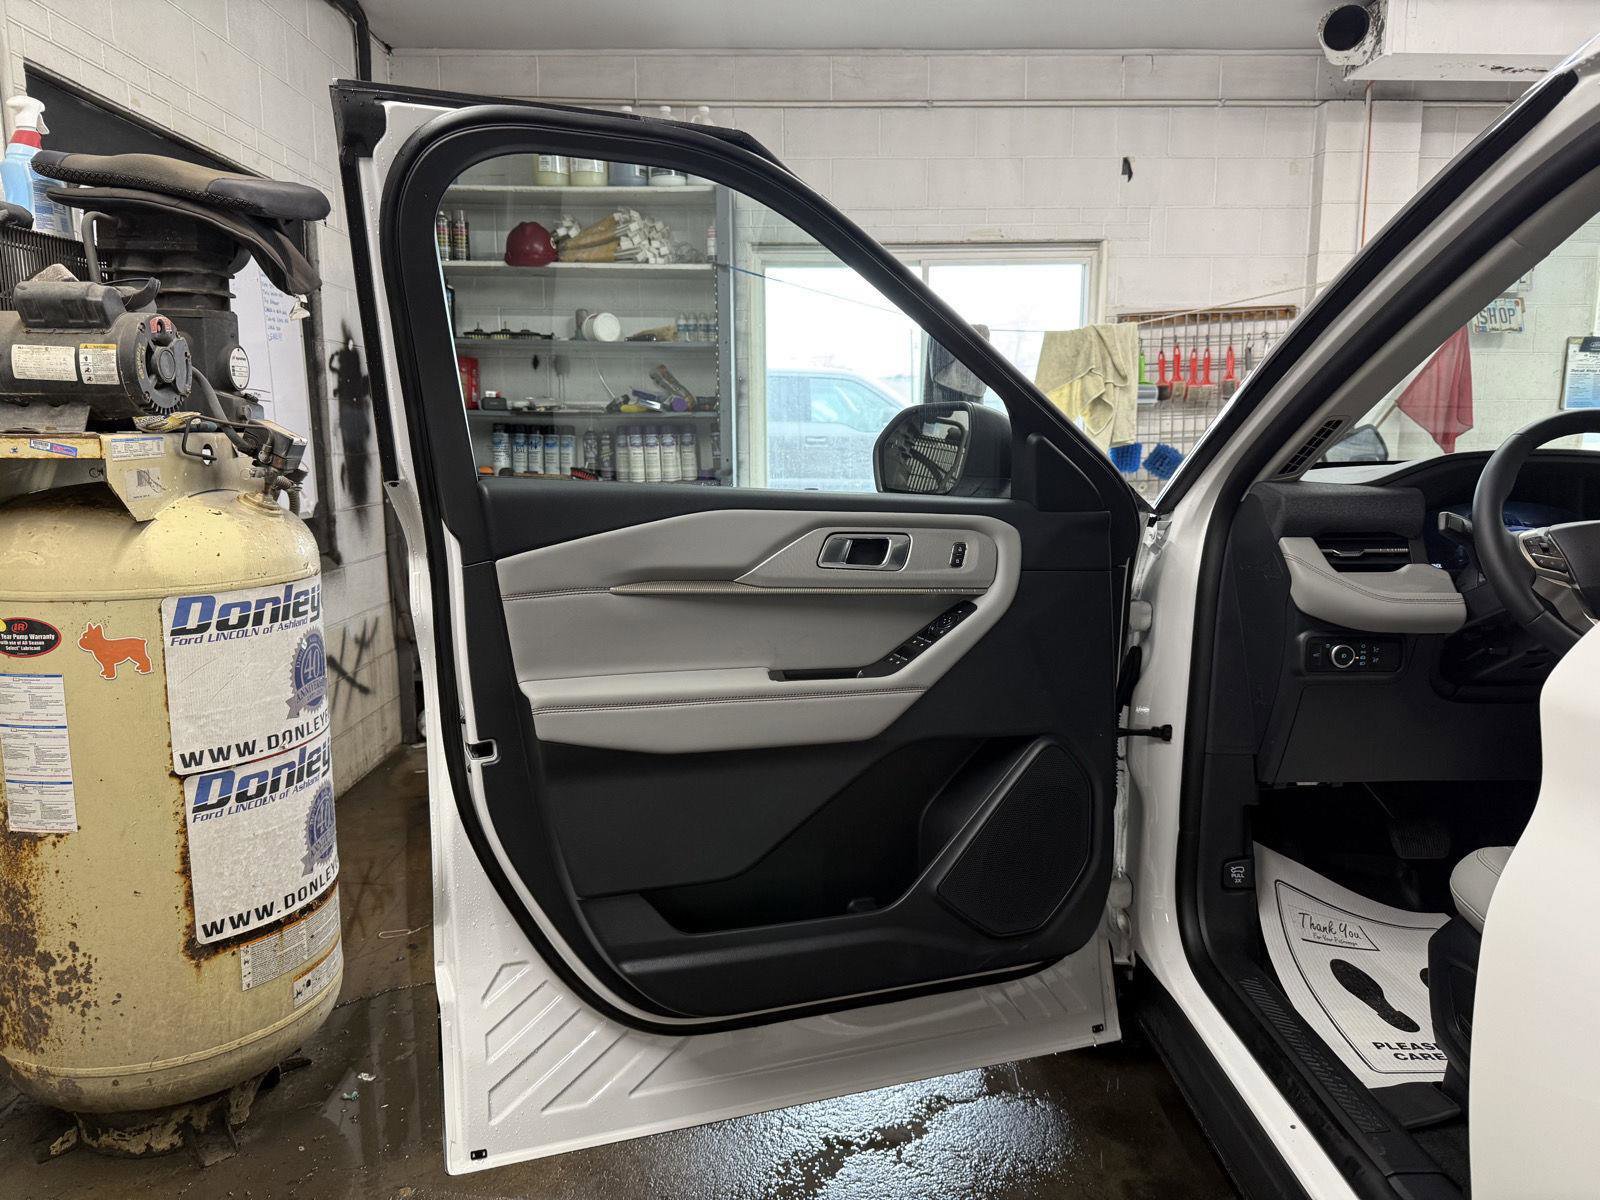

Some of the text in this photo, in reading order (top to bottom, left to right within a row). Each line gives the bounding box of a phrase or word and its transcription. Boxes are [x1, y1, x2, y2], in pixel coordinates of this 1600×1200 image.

[170, 584, 320, 636] Donley
[171, 616, 309, 646] Ford LINCOLN of Ashland
[192, 737, 331, 814] Donley
[192, 773, 321, 823] Ford LINCOLN of Ashland
[1298, 912, 1362, 940] Thank You
